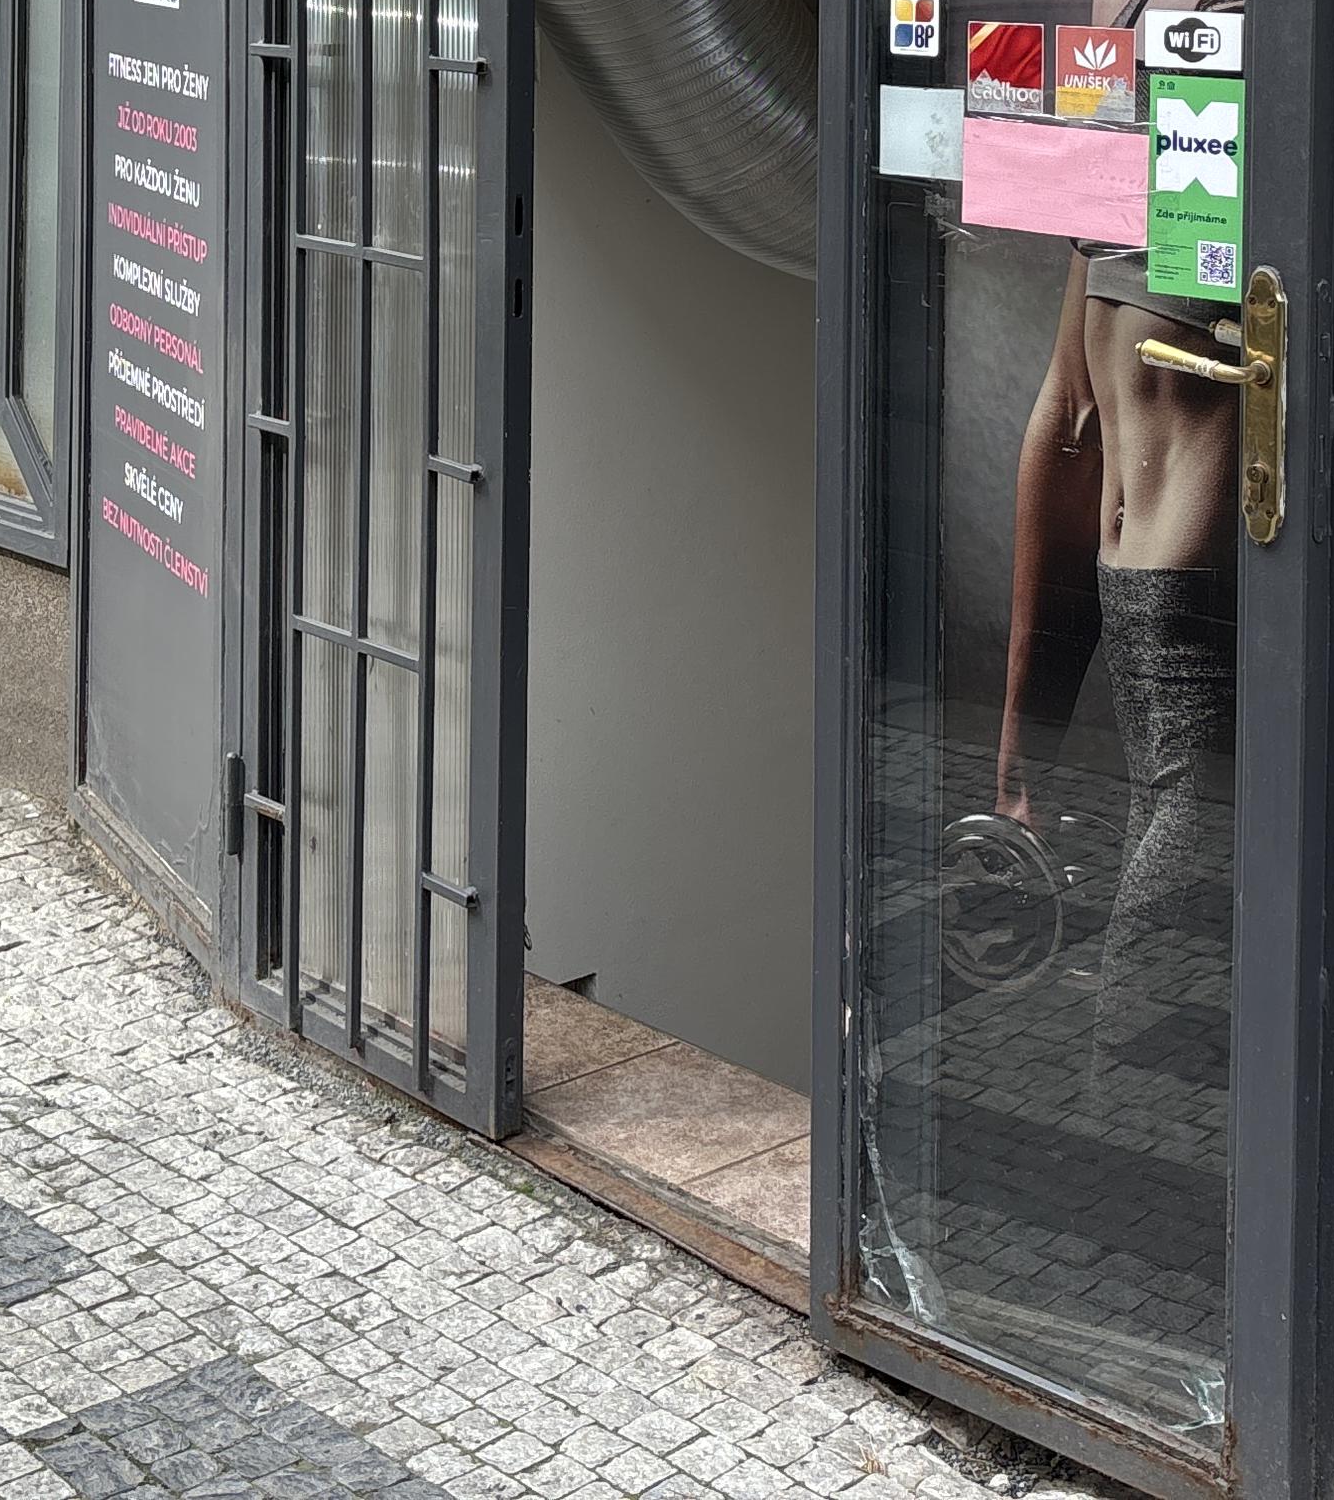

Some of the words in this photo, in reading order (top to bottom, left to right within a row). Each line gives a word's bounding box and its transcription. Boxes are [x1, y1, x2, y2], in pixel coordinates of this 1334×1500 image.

[914, 25, 935, 48] BP
[108, 52, 142, 84] FITNESS
[142, 61, 160, 90] JEN
[161, 66, 181, 94] PRO
[182, 64, 209, 101] ŽENY
[131, 110, 146, 136] OD
[146, 114, 173, 144] ROKU
[1156, 130, 1238, 157] pluxee
[114, 154, 133, 182] PRO
[134, 158, 172, 197] KAŽDOU
[173, 168, 201, 208] ŽENU
[108, 202, 166, 249] INDIVIDUÁLNÍ
[167, 219, 208, 266] PŘÍSTUP
[1156, 208, 1175, 219] Zde
[1177, 210, 1228, 225] přijímáme
[113, 253, 164, 300] KOMPLEXNÍ
[164, 278, 201, 318] SLUŽBY
[109, 302, 153, 345] ODBORNÝ
[154, 328, 204, 375] PERSONÁL
[108, 347, 151, 398] PŘÍJEMNÉ
[152, 376, 205, 431] PROSTŘEDÍ
[114, 404, 169, 461] PRAVIDELNÉ
[170, 442, 196, 480] AKCE
[124, 461, 157, 507] SKVĚLÉ
[158, 486, 184, 526] CENY
[102, 496, 119, 530] BEZ
[120, 510, 163, 563] NUTNOSTI
[164, 536, 208, 600] ČLENSTVÍ
